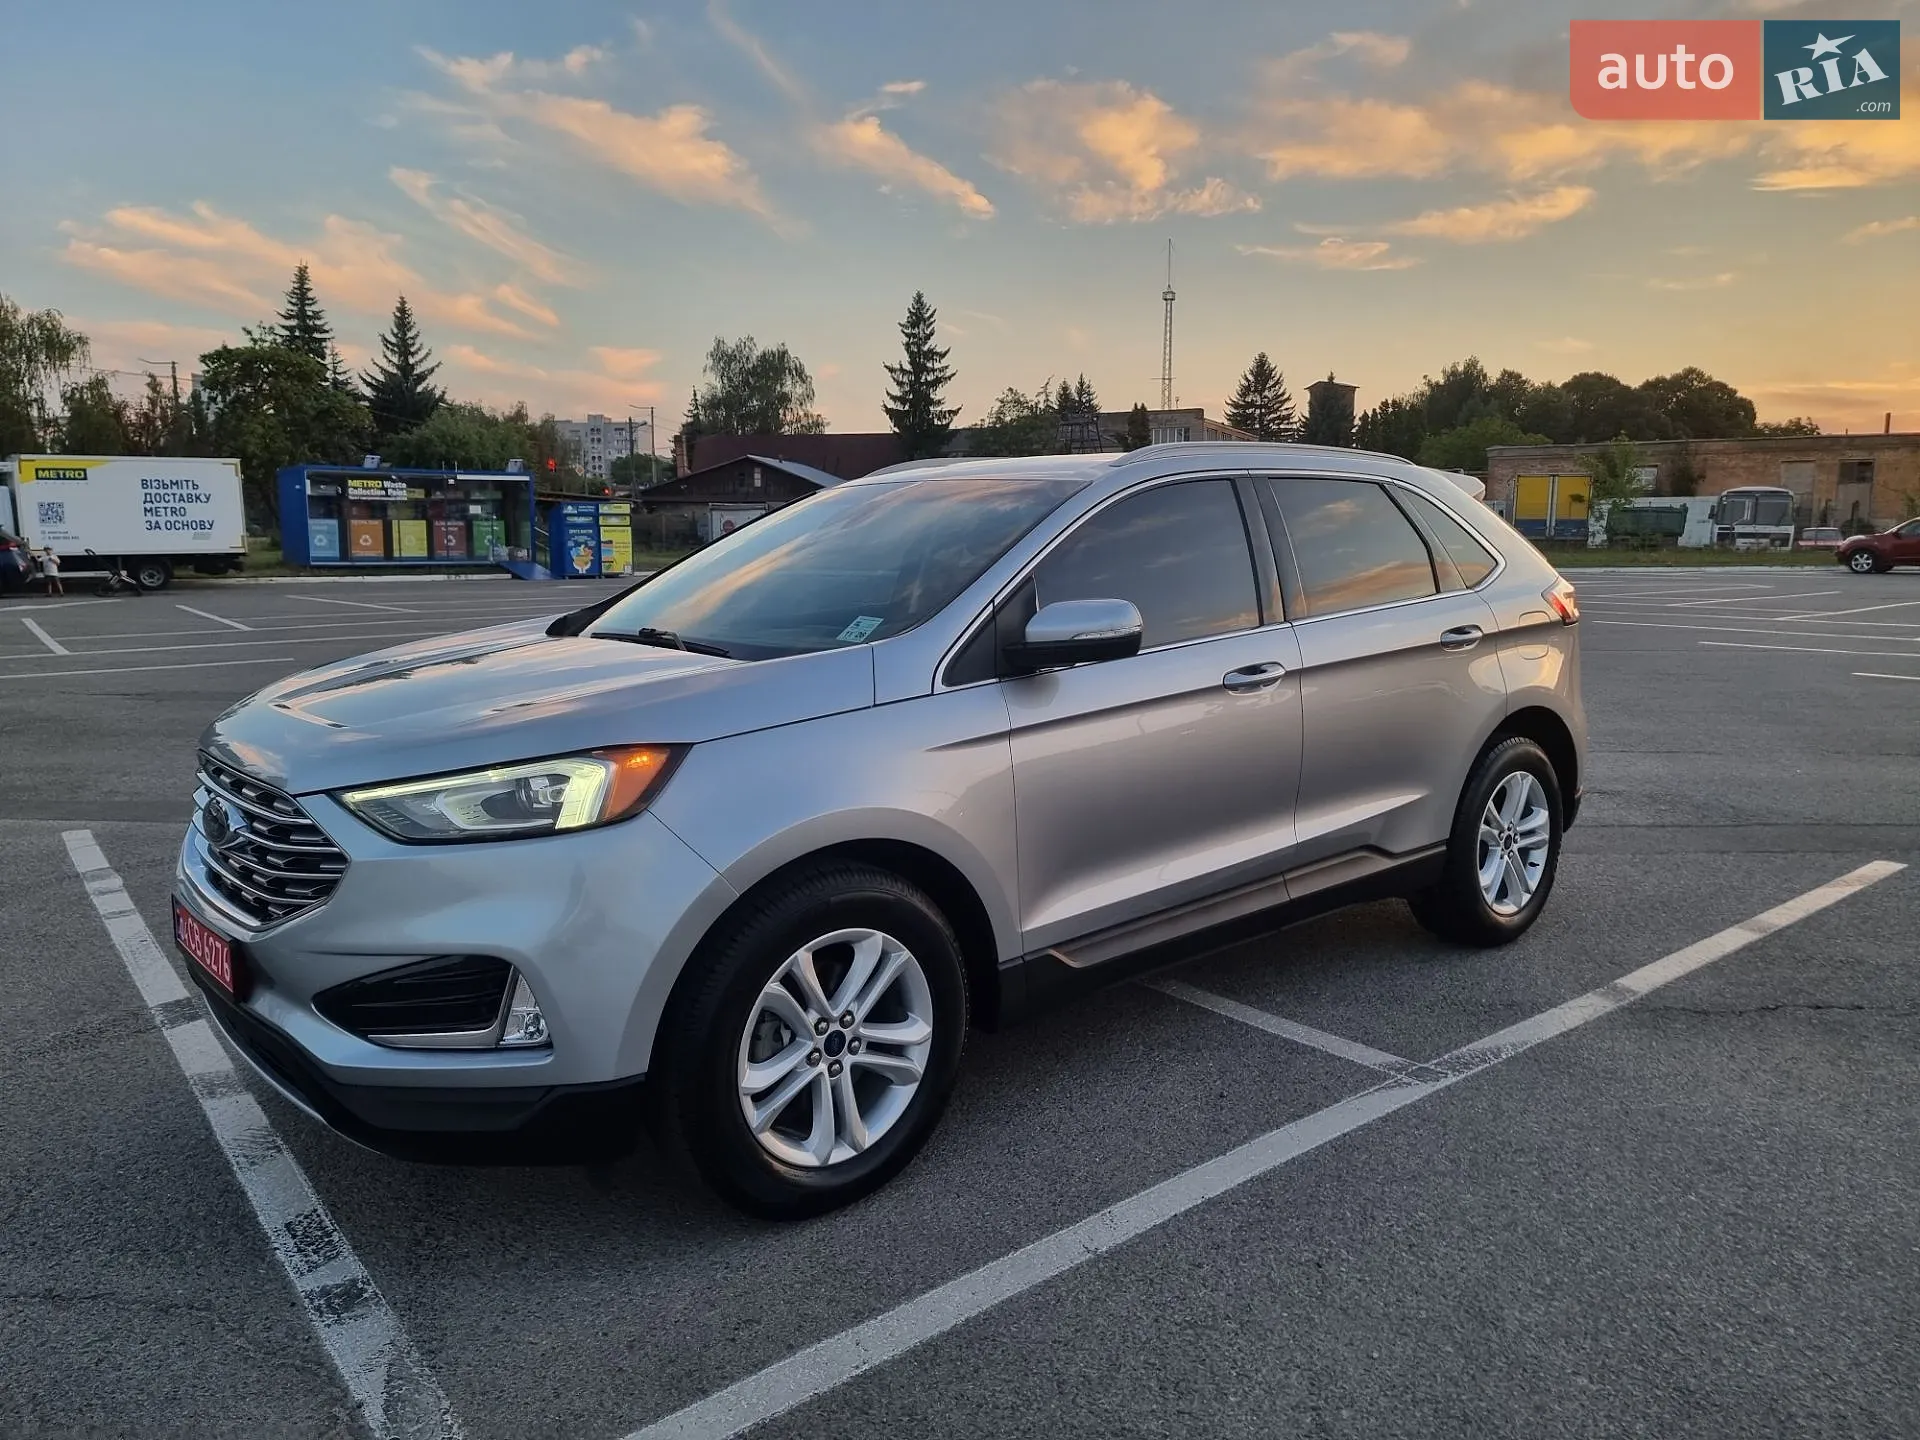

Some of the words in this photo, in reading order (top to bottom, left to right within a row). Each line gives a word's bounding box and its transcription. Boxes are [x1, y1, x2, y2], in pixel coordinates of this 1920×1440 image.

[37, 470, 84, 479] METRO
[140, 479, 200, 490] ВІЗЬМІТЬ
[347, 479, 382, 488] METRO
[383, 480, 407, 488] Waste
[347, 488, 386, 496] Collection
[142, 492, 212, 505] ДОСТАВКУ
[143, 506, 187, 517] METRO
[145, 520, 162, 531] ЗА
[164, 520, 215, 531] ОСНОВУ
